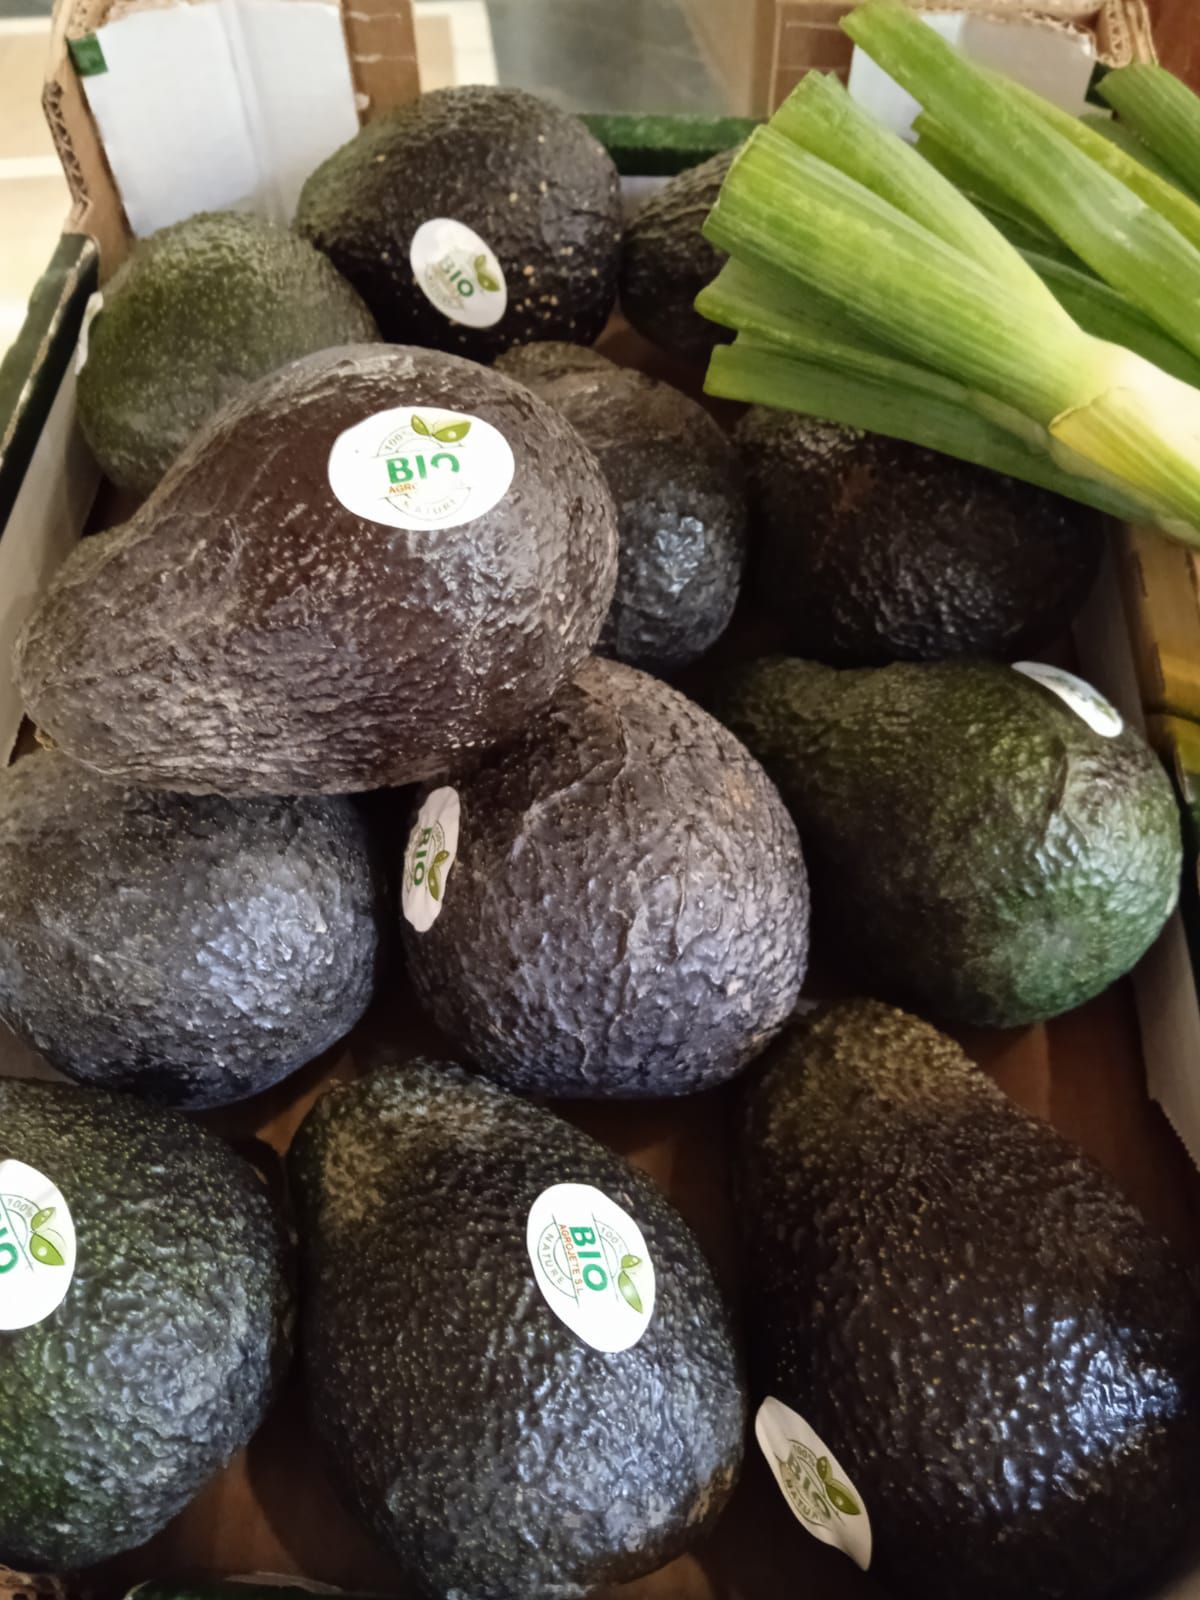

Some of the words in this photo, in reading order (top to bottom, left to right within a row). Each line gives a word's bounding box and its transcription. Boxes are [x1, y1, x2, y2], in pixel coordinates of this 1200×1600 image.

[413, 827, 433, 886] BIO
[542, 1233, 565, 1285] NATURE
[568, 1226, 609, 1292] BIO
